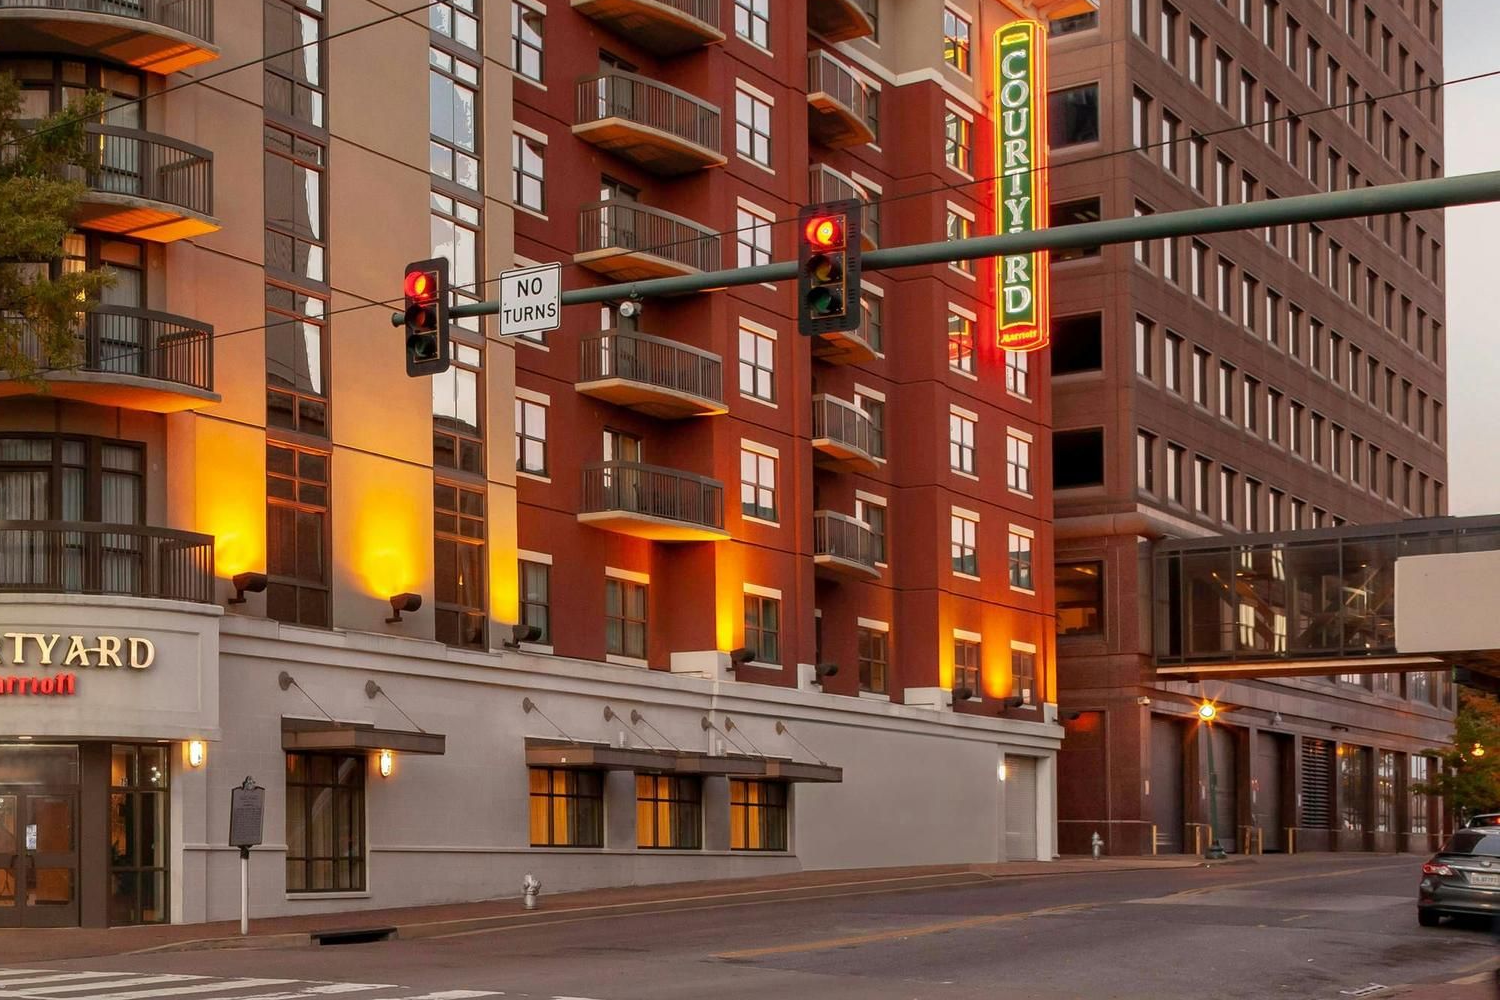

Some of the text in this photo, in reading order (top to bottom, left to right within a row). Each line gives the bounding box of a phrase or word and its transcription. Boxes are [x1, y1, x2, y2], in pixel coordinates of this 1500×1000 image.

[1000, 48, 1032, 314] COURTYRD
[517, 277, 543, 298] NO
[503, 302, 557, 325] TURNS
